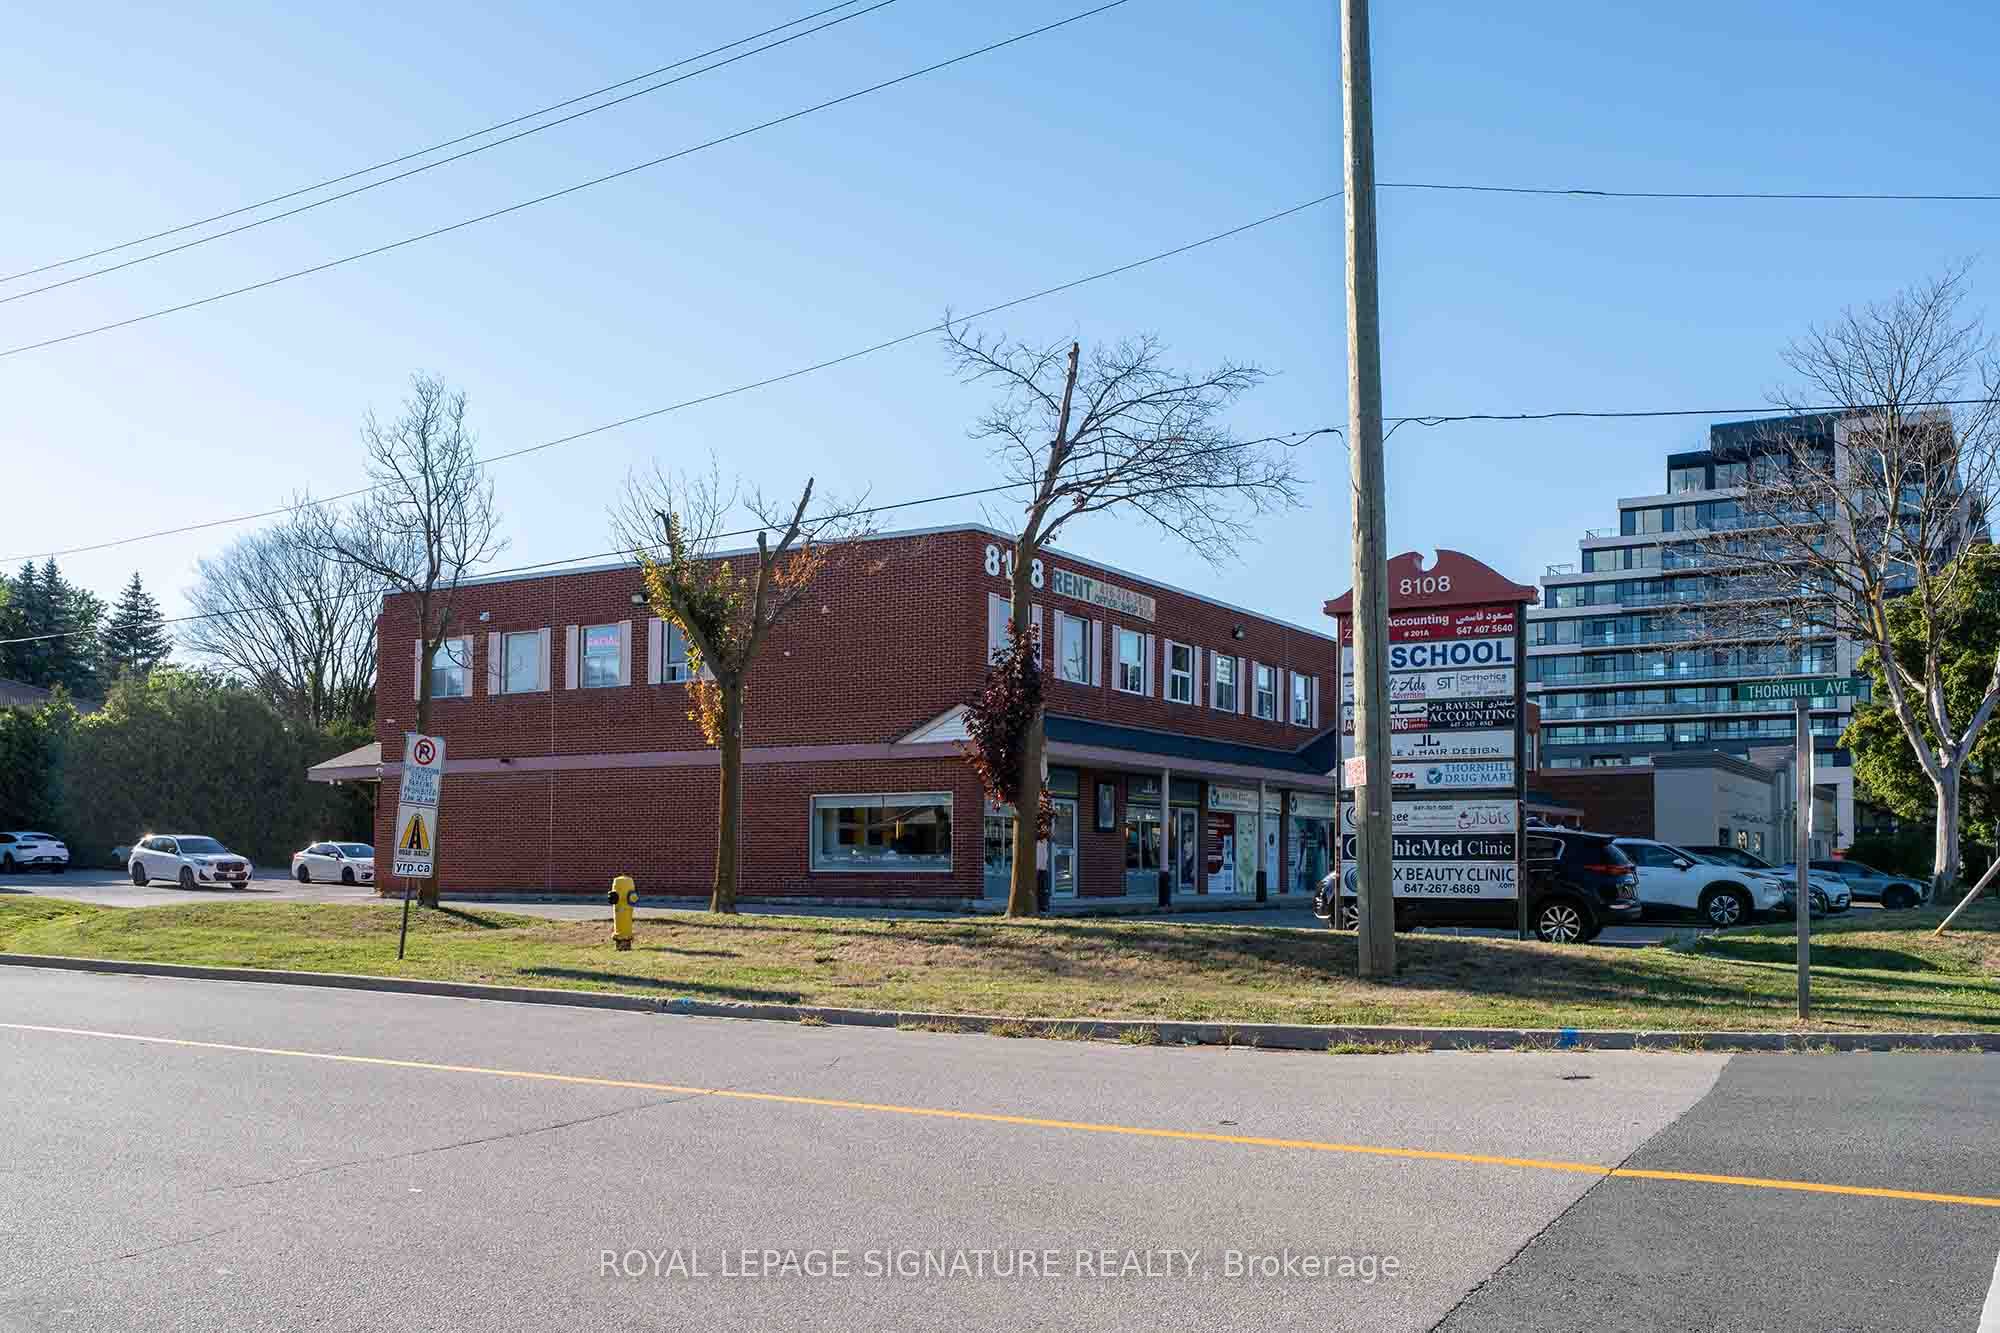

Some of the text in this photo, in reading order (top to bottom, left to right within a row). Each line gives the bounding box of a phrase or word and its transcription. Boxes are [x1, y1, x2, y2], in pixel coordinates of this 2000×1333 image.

[985, 544, 1044, 590] 818
[1053, 570, 1092, 601] RENT
[1400, 576, 1451, 595] 8108
[1388, 614, 1449, 626] Accounting
[1410, 630, 1430, 638] 201A
[1456, 623, 1513, 635] 647 407 5640
[1391, 641, 1513, 668] SCHOOL
[1461, 672, 1506, 681] Orthotics
[1749, 681, 1849, 698] THORNHILL AVE
[1445, 701, 1484, 711] RAVESH
[1429, 709, 1515, 722] ACCOUNTING
[1452, 747, 1500, 755] DESIGN
[1445, 762, 1511, 773] THORNHILL
[1445, 772, 1512, 783] DRUG MART
[1392, 839, 1512, 856] hicMed Clinic
[396, 863, 431, 873] yrp.ca
[1406, 868, 1464, 881] BEAUTY
[1467, 868, 1515, 881] CLINIC
[1404, 883, 1480, 894] 647-267-6869
